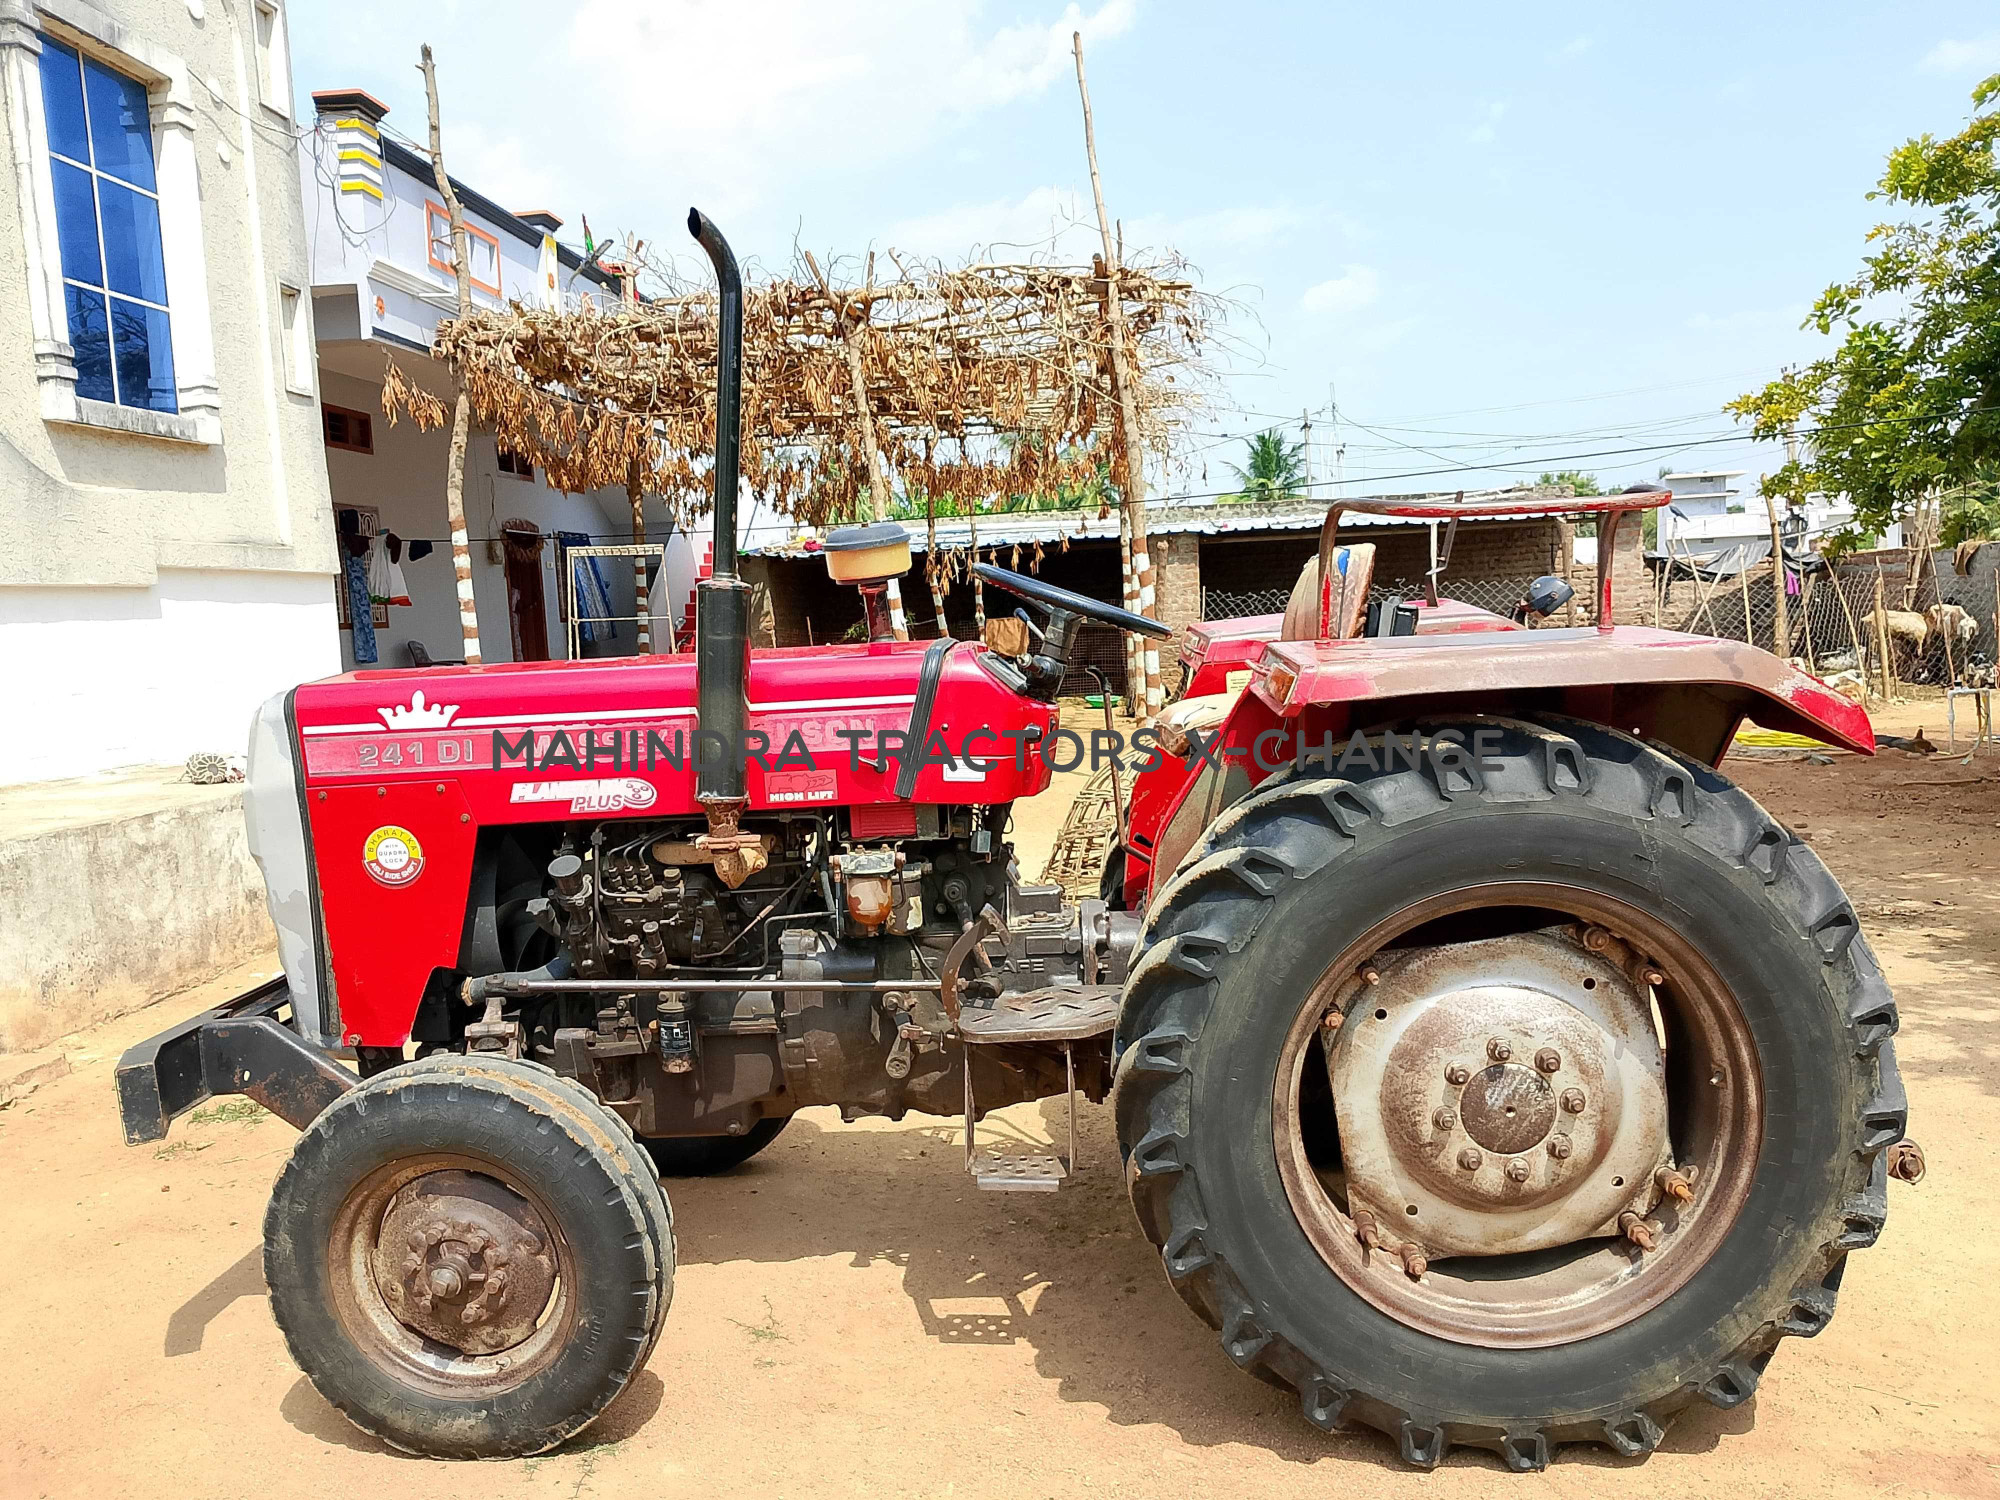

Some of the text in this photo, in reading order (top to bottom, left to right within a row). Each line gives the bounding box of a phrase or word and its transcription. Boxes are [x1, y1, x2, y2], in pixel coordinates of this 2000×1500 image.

[359, 738, 473, 767] 241 DI
[573, 794, 623, 810] PLUS
[769, 790, 834, 802] HIGH LIFT
[368, 829, 417, 852] BHARAT KA
